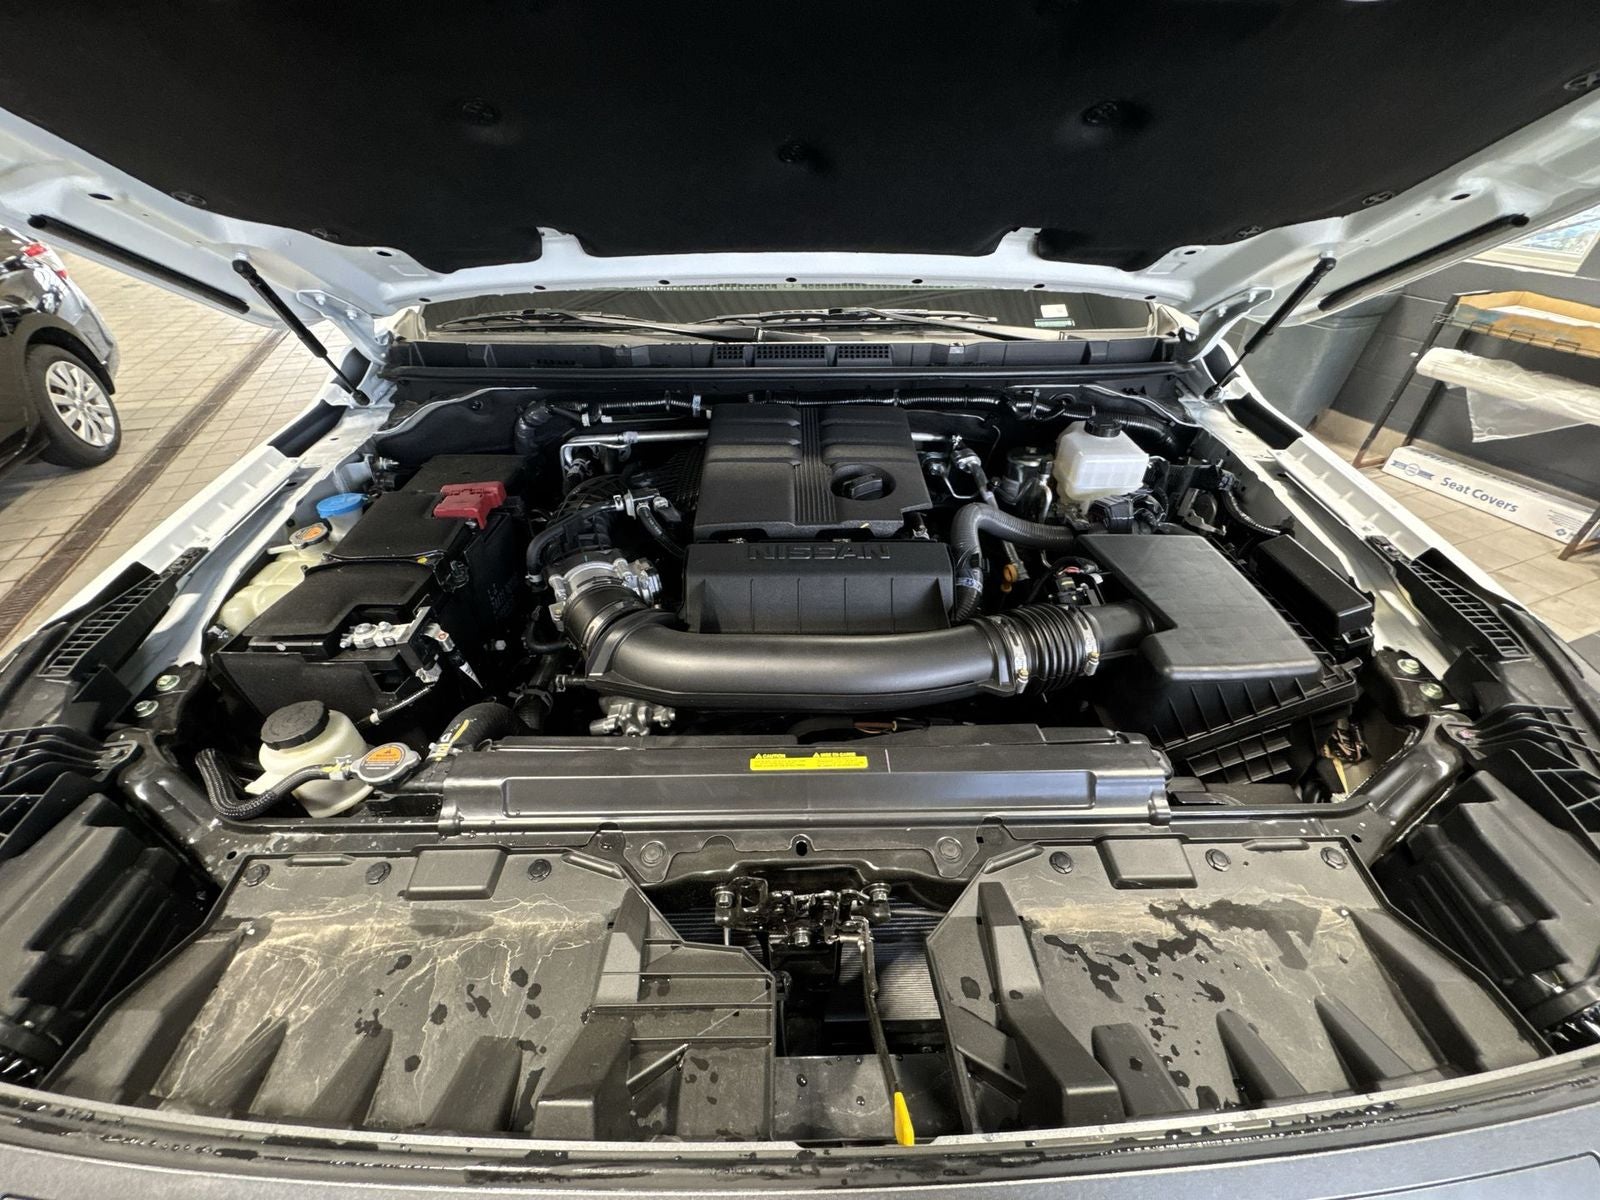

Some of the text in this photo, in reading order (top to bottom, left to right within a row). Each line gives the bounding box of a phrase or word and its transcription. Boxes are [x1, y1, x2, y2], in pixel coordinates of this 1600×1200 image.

[1440, 477, 1471, 494] Seat
[1472, 489, 1519, 513] Covers
[749, 544, 891, 560] NISSAN
